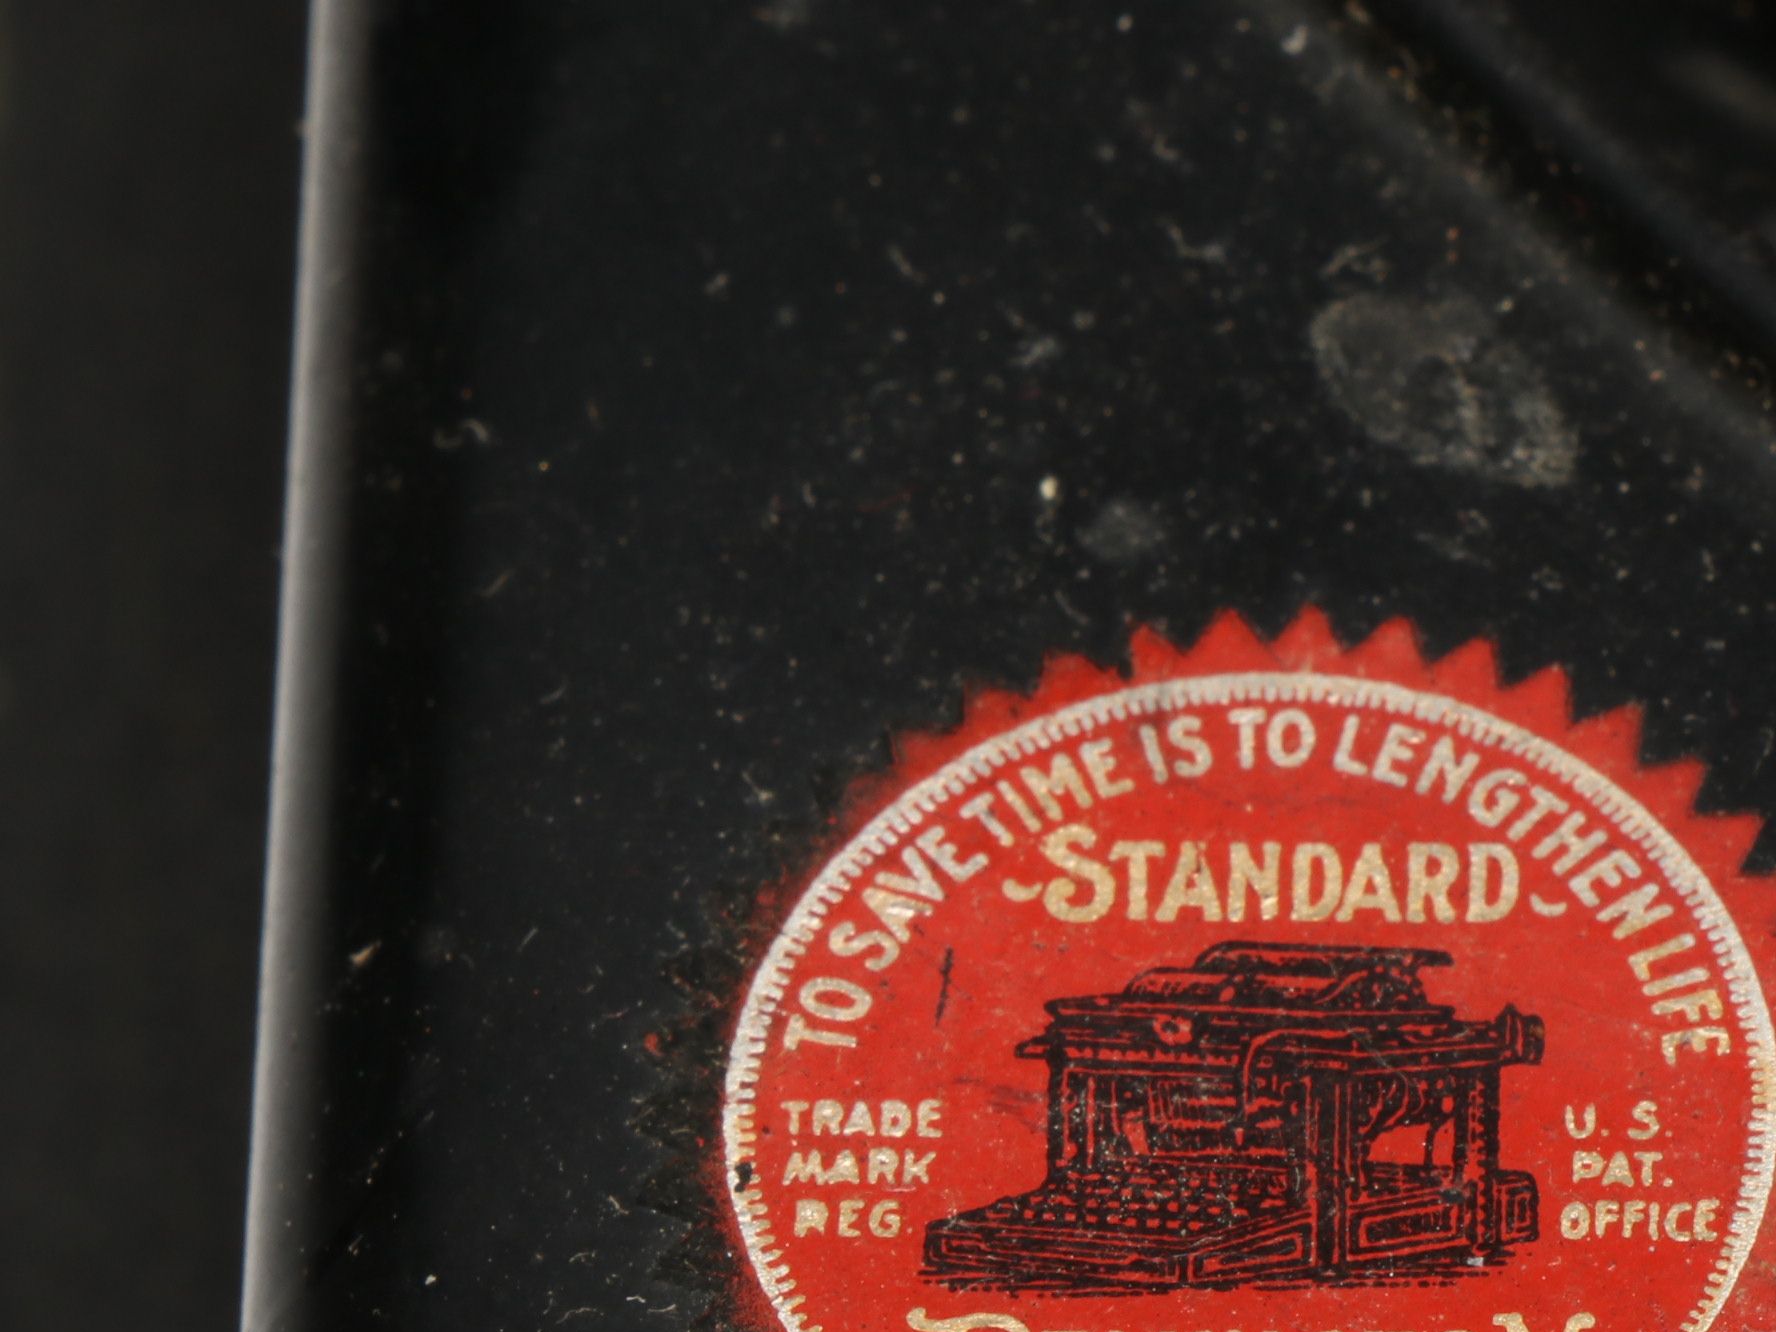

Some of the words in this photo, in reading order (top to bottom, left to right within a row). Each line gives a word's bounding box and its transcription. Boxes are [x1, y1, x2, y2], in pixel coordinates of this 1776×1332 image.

[783, 976, 873, 1050] TO
[828, 825, 989, 972] SAVE
[959, 738, 1135, 847] TIME
[1139, 716, 1212, 784] IS
[1228, 707, 1316, 769] TO
[1333, 714, 1674, 940] LENGTHEN
[1627, 933, 1731, 1066] LIFE
[1040, 824, 1520, 923] STANDARD
[780, 1099, 943, 1138] TRADE
[782, 1147, 936, 1186] MARK
[1572, 1150, 1674, 1187] PAT.
[1560, 1198, 1720, 1241] OFFICE
